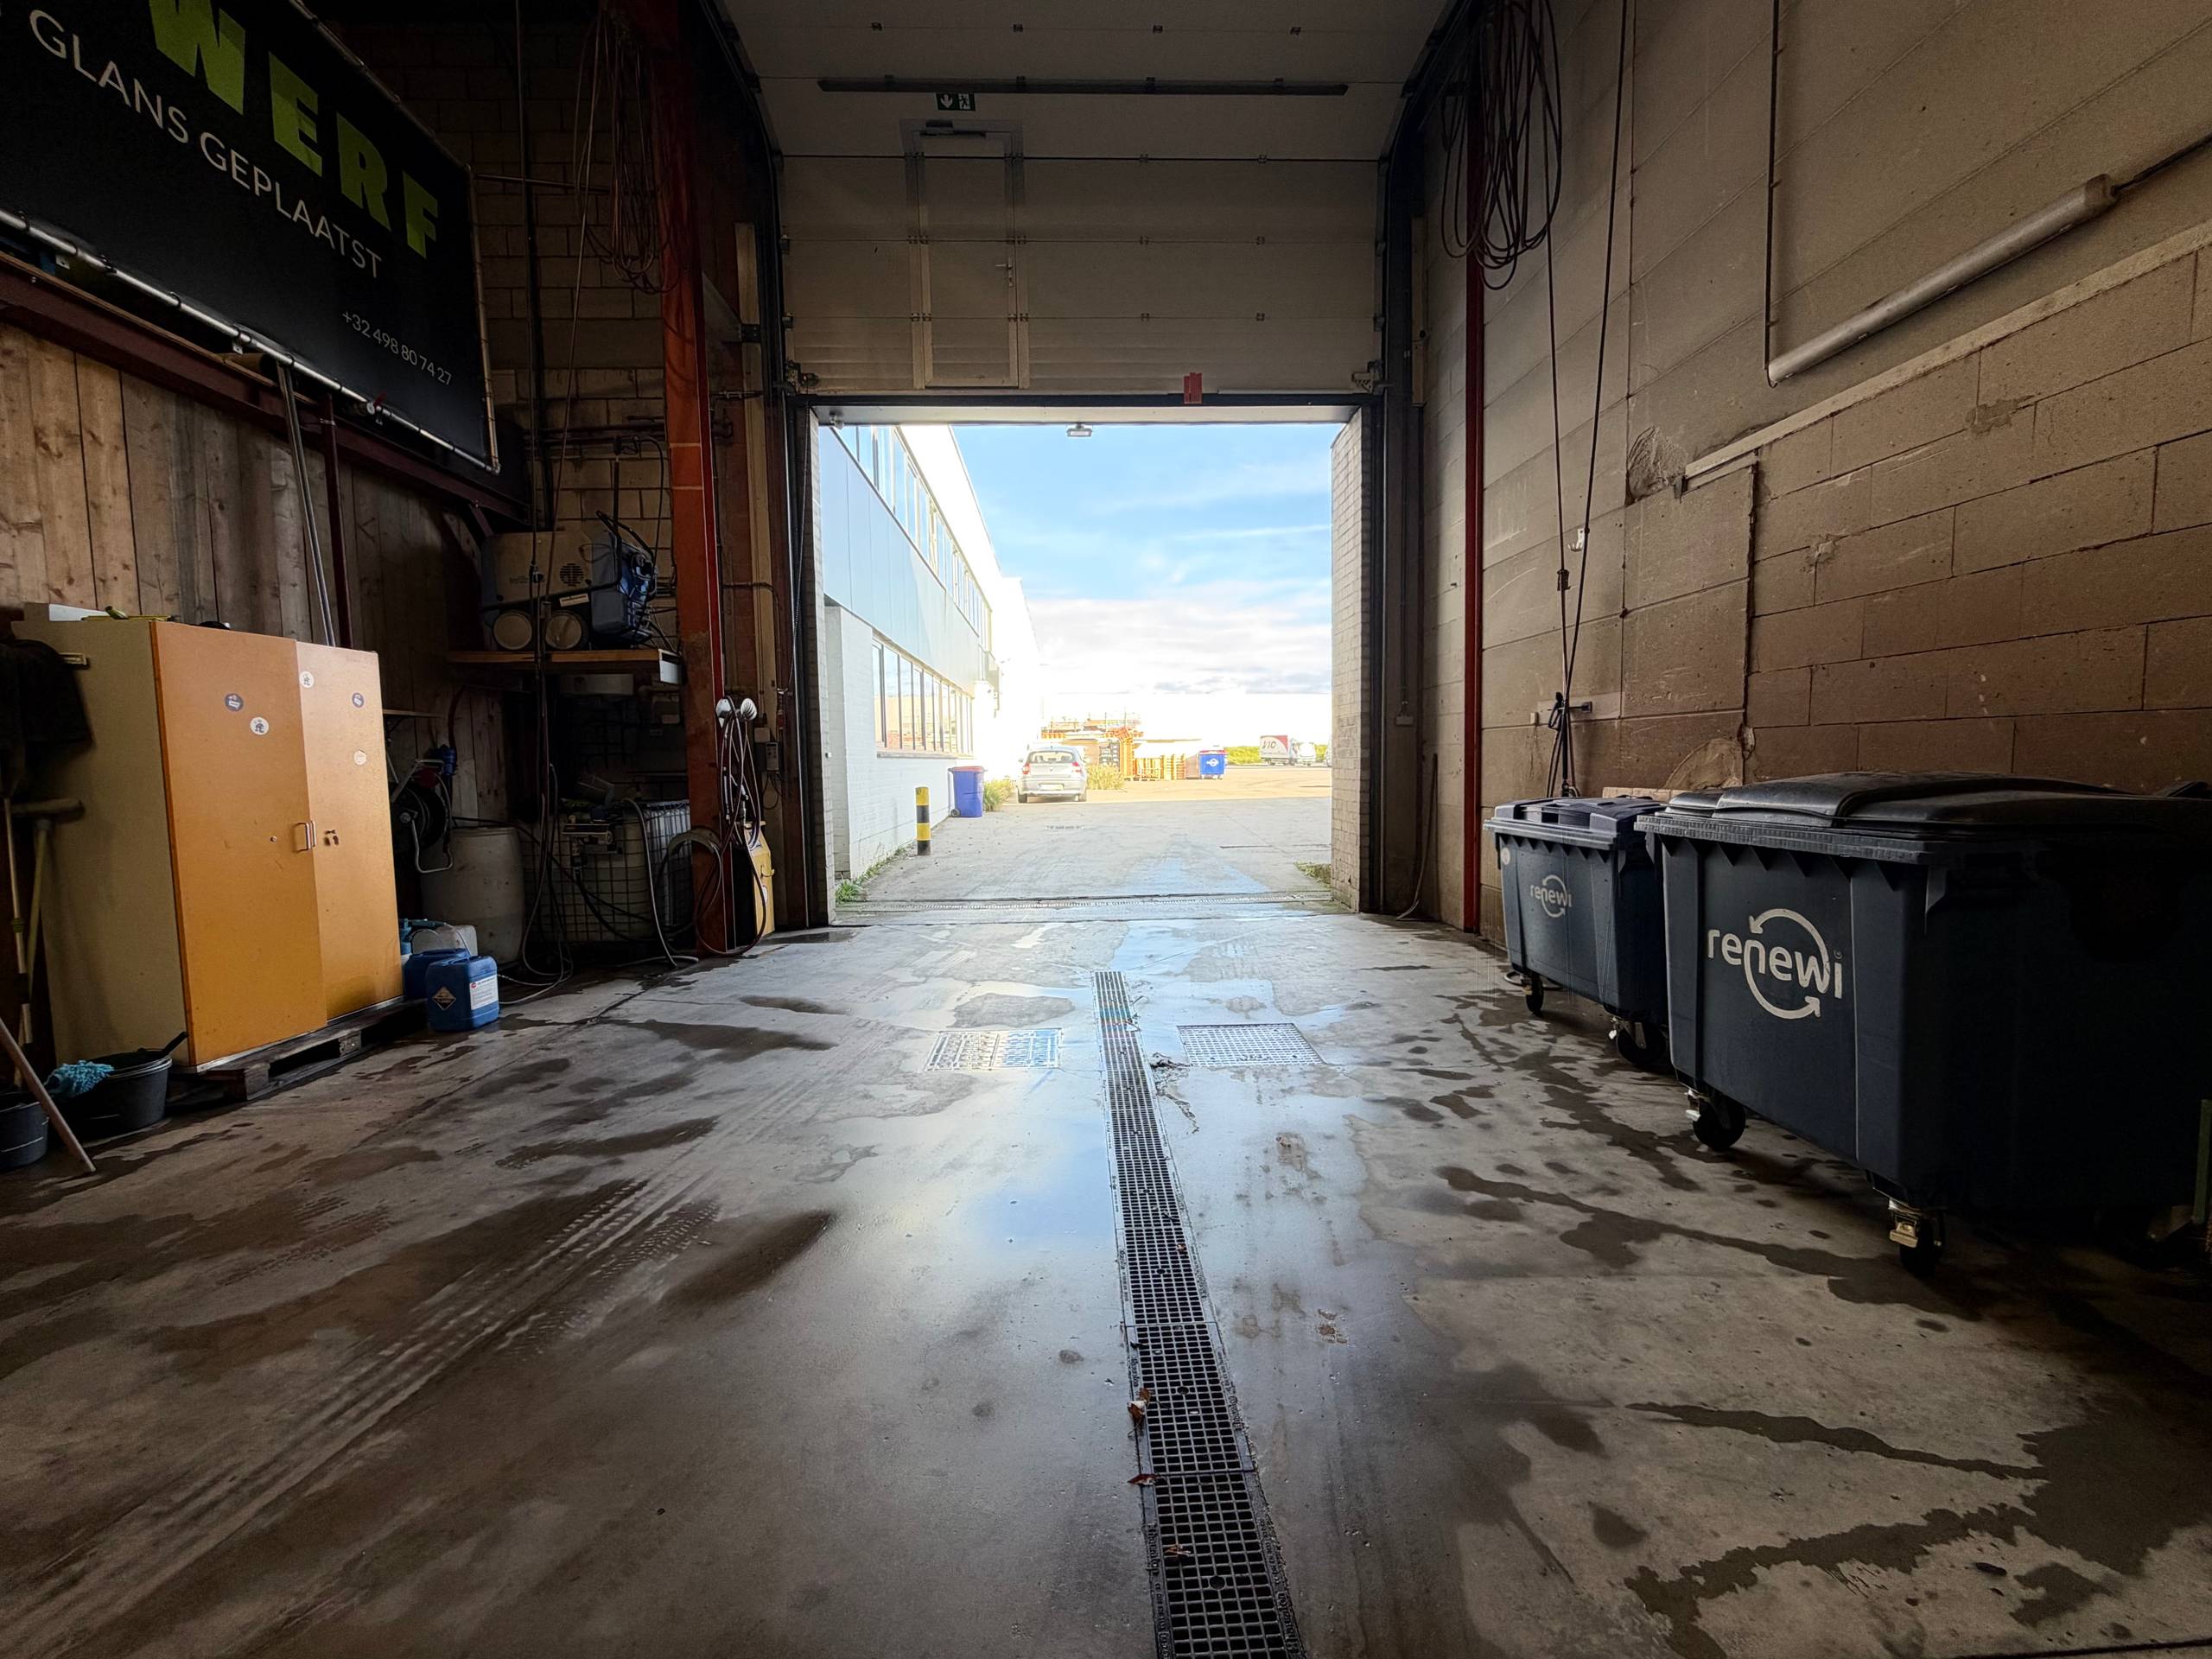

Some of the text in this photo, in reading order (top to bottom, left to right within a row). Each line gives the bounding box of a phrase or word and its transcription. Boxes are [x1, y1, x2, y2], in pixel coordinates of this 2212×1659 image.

[29, 10, 382, 278] GLANS GEPLAATST
[149, 0, 438, 258] WERF
[342, 312, 452, 385] +32 498 80 74 27
[1529, 884, 1573, 907] renewi
[1707, 929, 1843, 1000] renewi
